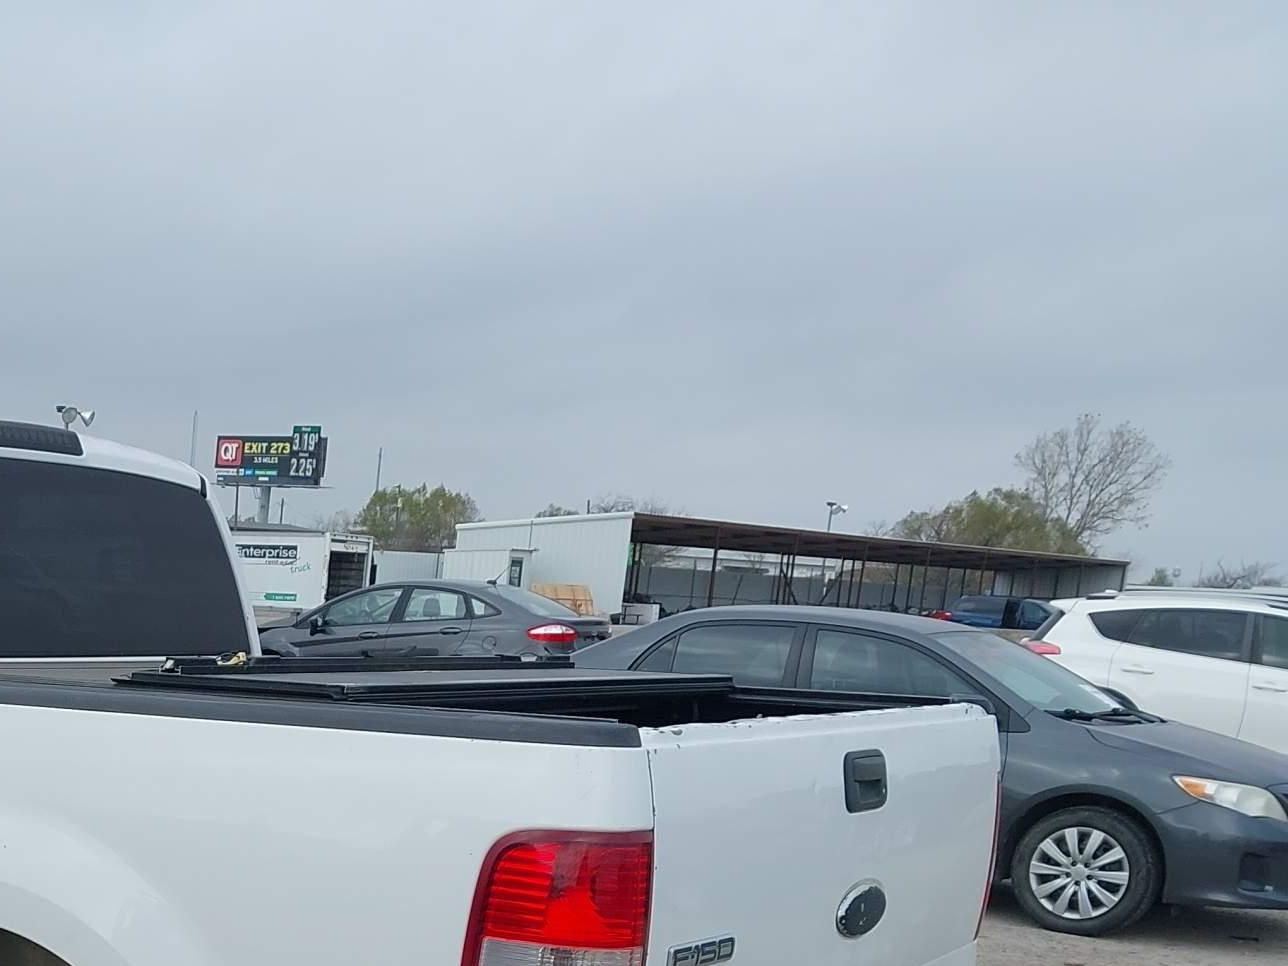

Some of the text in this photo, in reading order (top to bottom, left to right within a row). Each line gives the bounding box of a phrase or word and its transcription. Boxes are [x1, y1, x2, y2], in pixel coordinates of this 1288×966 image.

[220, 443, 238, 461] QT
[243, 442, 291, 454] EXIT 273
